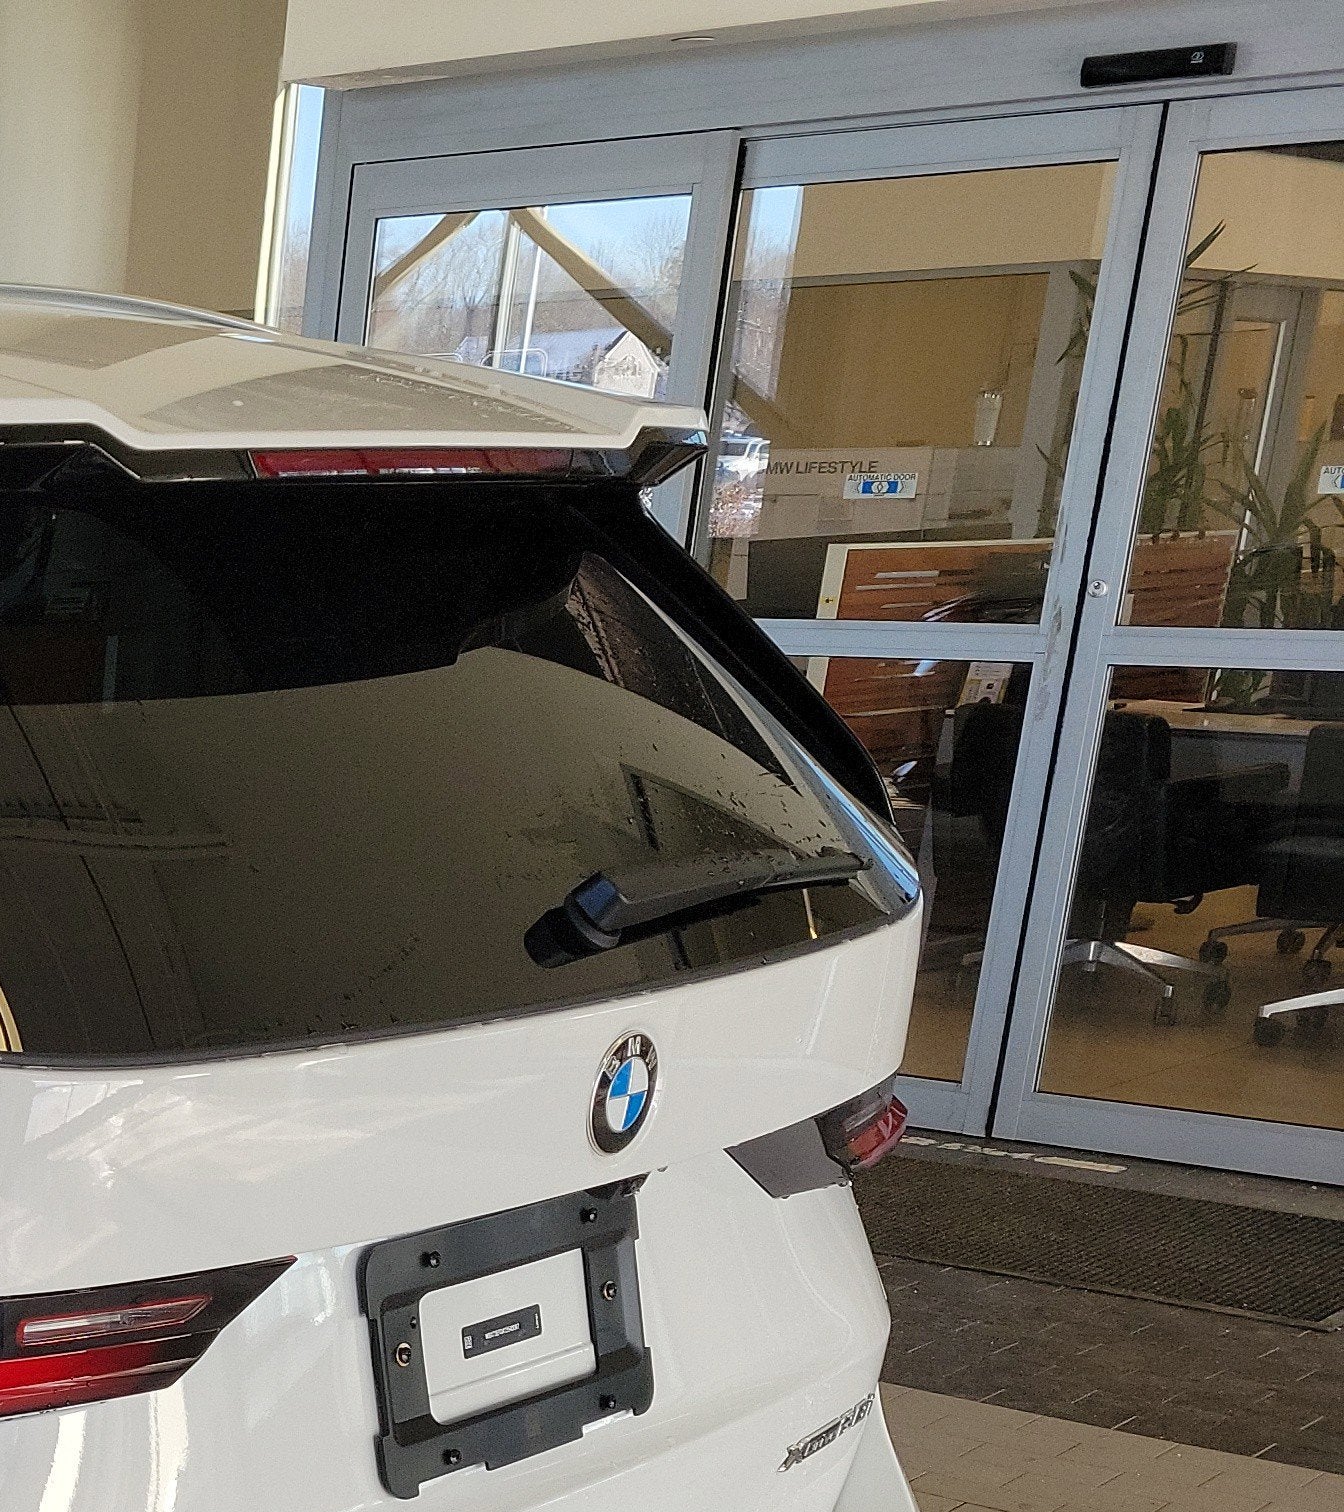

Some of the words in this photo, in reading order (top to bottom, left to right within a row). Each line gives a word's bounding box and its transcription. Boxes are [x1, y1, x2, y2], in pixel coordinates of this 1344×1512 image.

[764, 460, 793, 475] MW
[796, 459, 879, 475] LIFESTYLE
[847, 473, 892, 482] AUTOMATIC
[893, 473, 916, 481] DOOR
